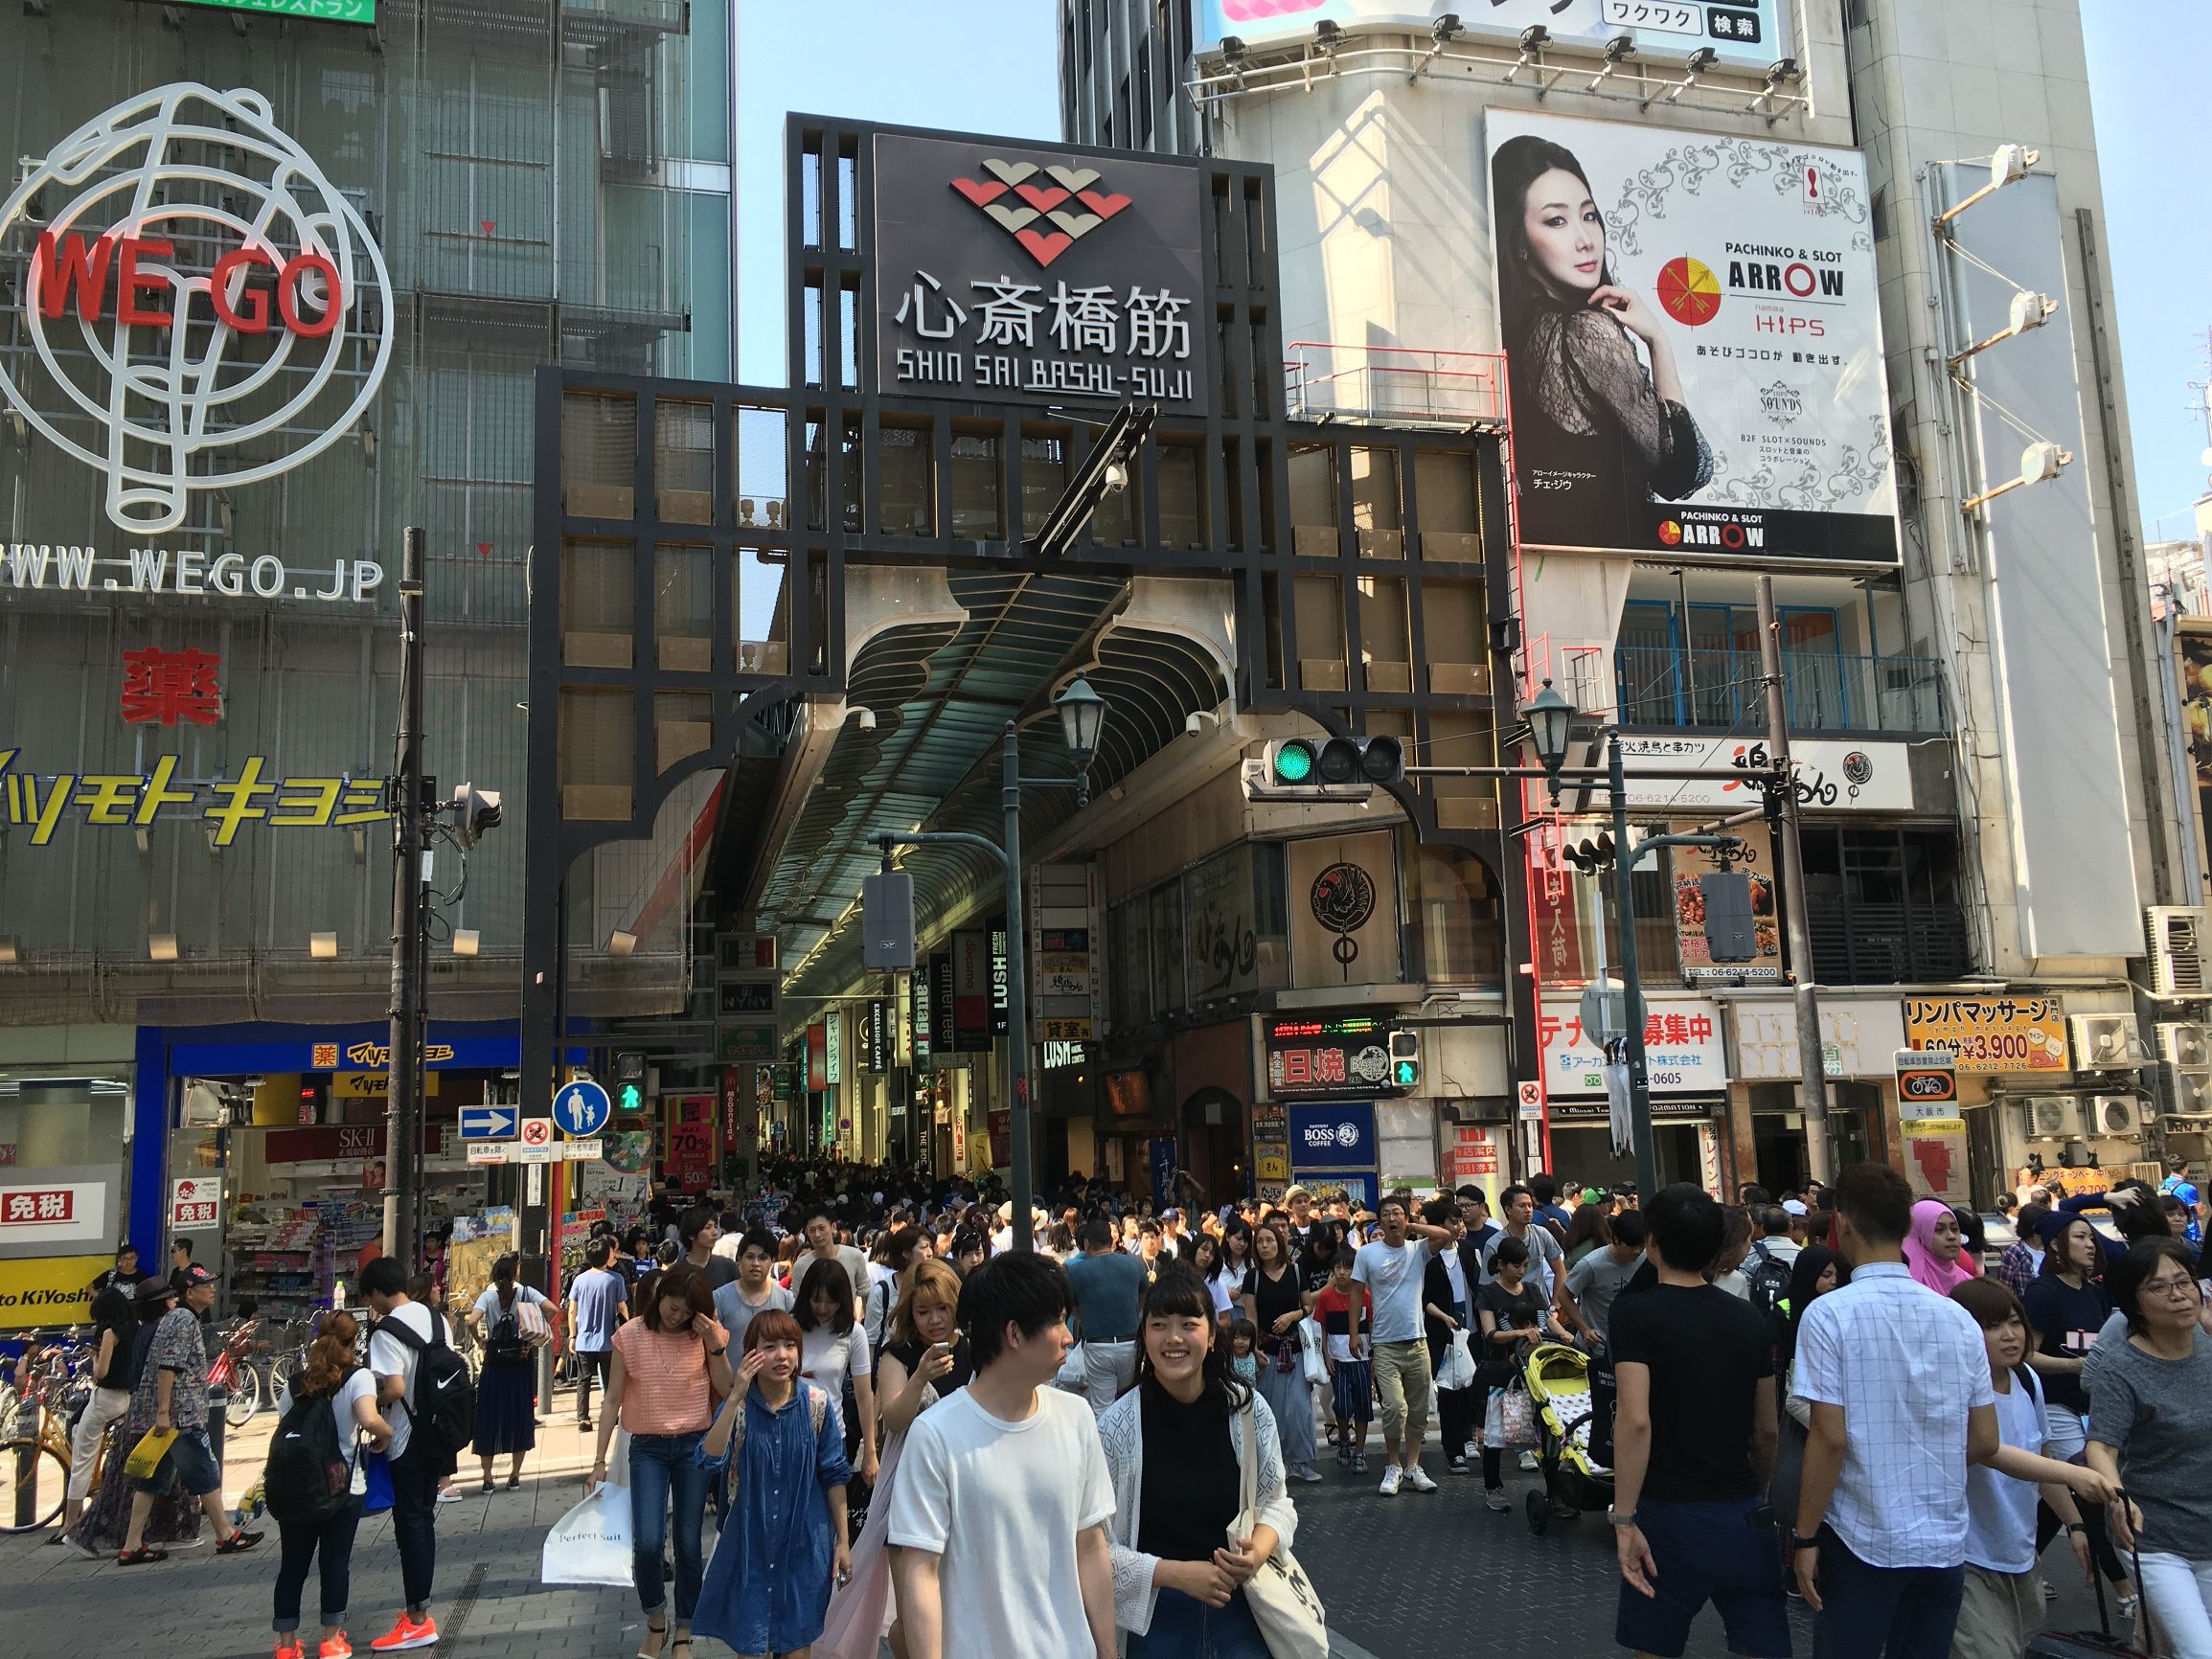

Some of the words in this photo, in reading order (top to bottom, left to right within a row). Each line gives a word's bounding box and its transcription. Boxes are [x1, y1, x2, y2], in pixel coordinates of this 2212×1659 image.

[1612, 2, 1692, 28] ワクワク
[1714, 14, 1756, 36] 検索
[1725, 242, 1794, 259] PACHINKO
[1798, 249, 1809, 260] &
[1813, 251, 1842, 263] SLOT
[1728, 261, 1844, 297] ARROW
[895, 269, 1193, 360] 心斎橋筋
[1696, 345, 1784, 362] あそびゴコロが
[1792, 352, 1848, 368] 動き出す。
[897, 349, 963, 383] SHIN
[974, 353, 1020, 388] SAI
[1760, 397, 1803, 416] SOUNDS
[1741, 434, 1756, 443] B2F
[1759, 445, 1810, 456] スロットと音楽の
[1759, 455, 1811, 465] コラボレーション
[1532, 469, 1597, 479] アローイメージキャラクター
[1533, 480, 1572, 490] チェ・ジウ
[1680, 511, 1729, 523] PACHINKO
[1731, 513, 1739, 523] &
[1741, 514, 1763, 524] SLOT
[1683, 523, 1764, 548] ARROW
[0, 543, 384, 602] WW.WEGO.JP
[120, 647, 224, 726] 薬
[965, 939, 976, 989] docomo
[993, 957, 1008, 1009] LUSH
[724, 997, 768, 1009] NYNY
[1906, 999, 2048, 1025] リンパマッサージ
[2049, 998, 2061, 1023] 専門店
[996, 1021, 1007, 1030] 1F
[1540, 1012, 1713, 1047] テナ募集中
[1974, 1025, 2029, 1034] massage
[314, 1045, 334, 1065] 薬
[828, 1014, 838, 1081] ジャパンライフ
[1044, 1040, 1071, 1069] LUSH
[1962, 1034, 2029, 1061] ¥3,900
[1285, 1049, 1346, 1084] 日焼
[1897, 1057, 1952, 1067] 自転車放置禁止区域
[1916, 1105, 1946, 1117] 大阪市
[673, 1134, 712, 1150] 70%
[1304, 1128, 1335, 1141] BOSS
[469, 1146, 506, 1155] 自転車を除く
[9, 1193, 66, 1220] 免税
[180, 1203, 212, 1221] 免税
[559, 1533, 597, 1543] Perfect
[600, 1533, 622, 1541] Suit
